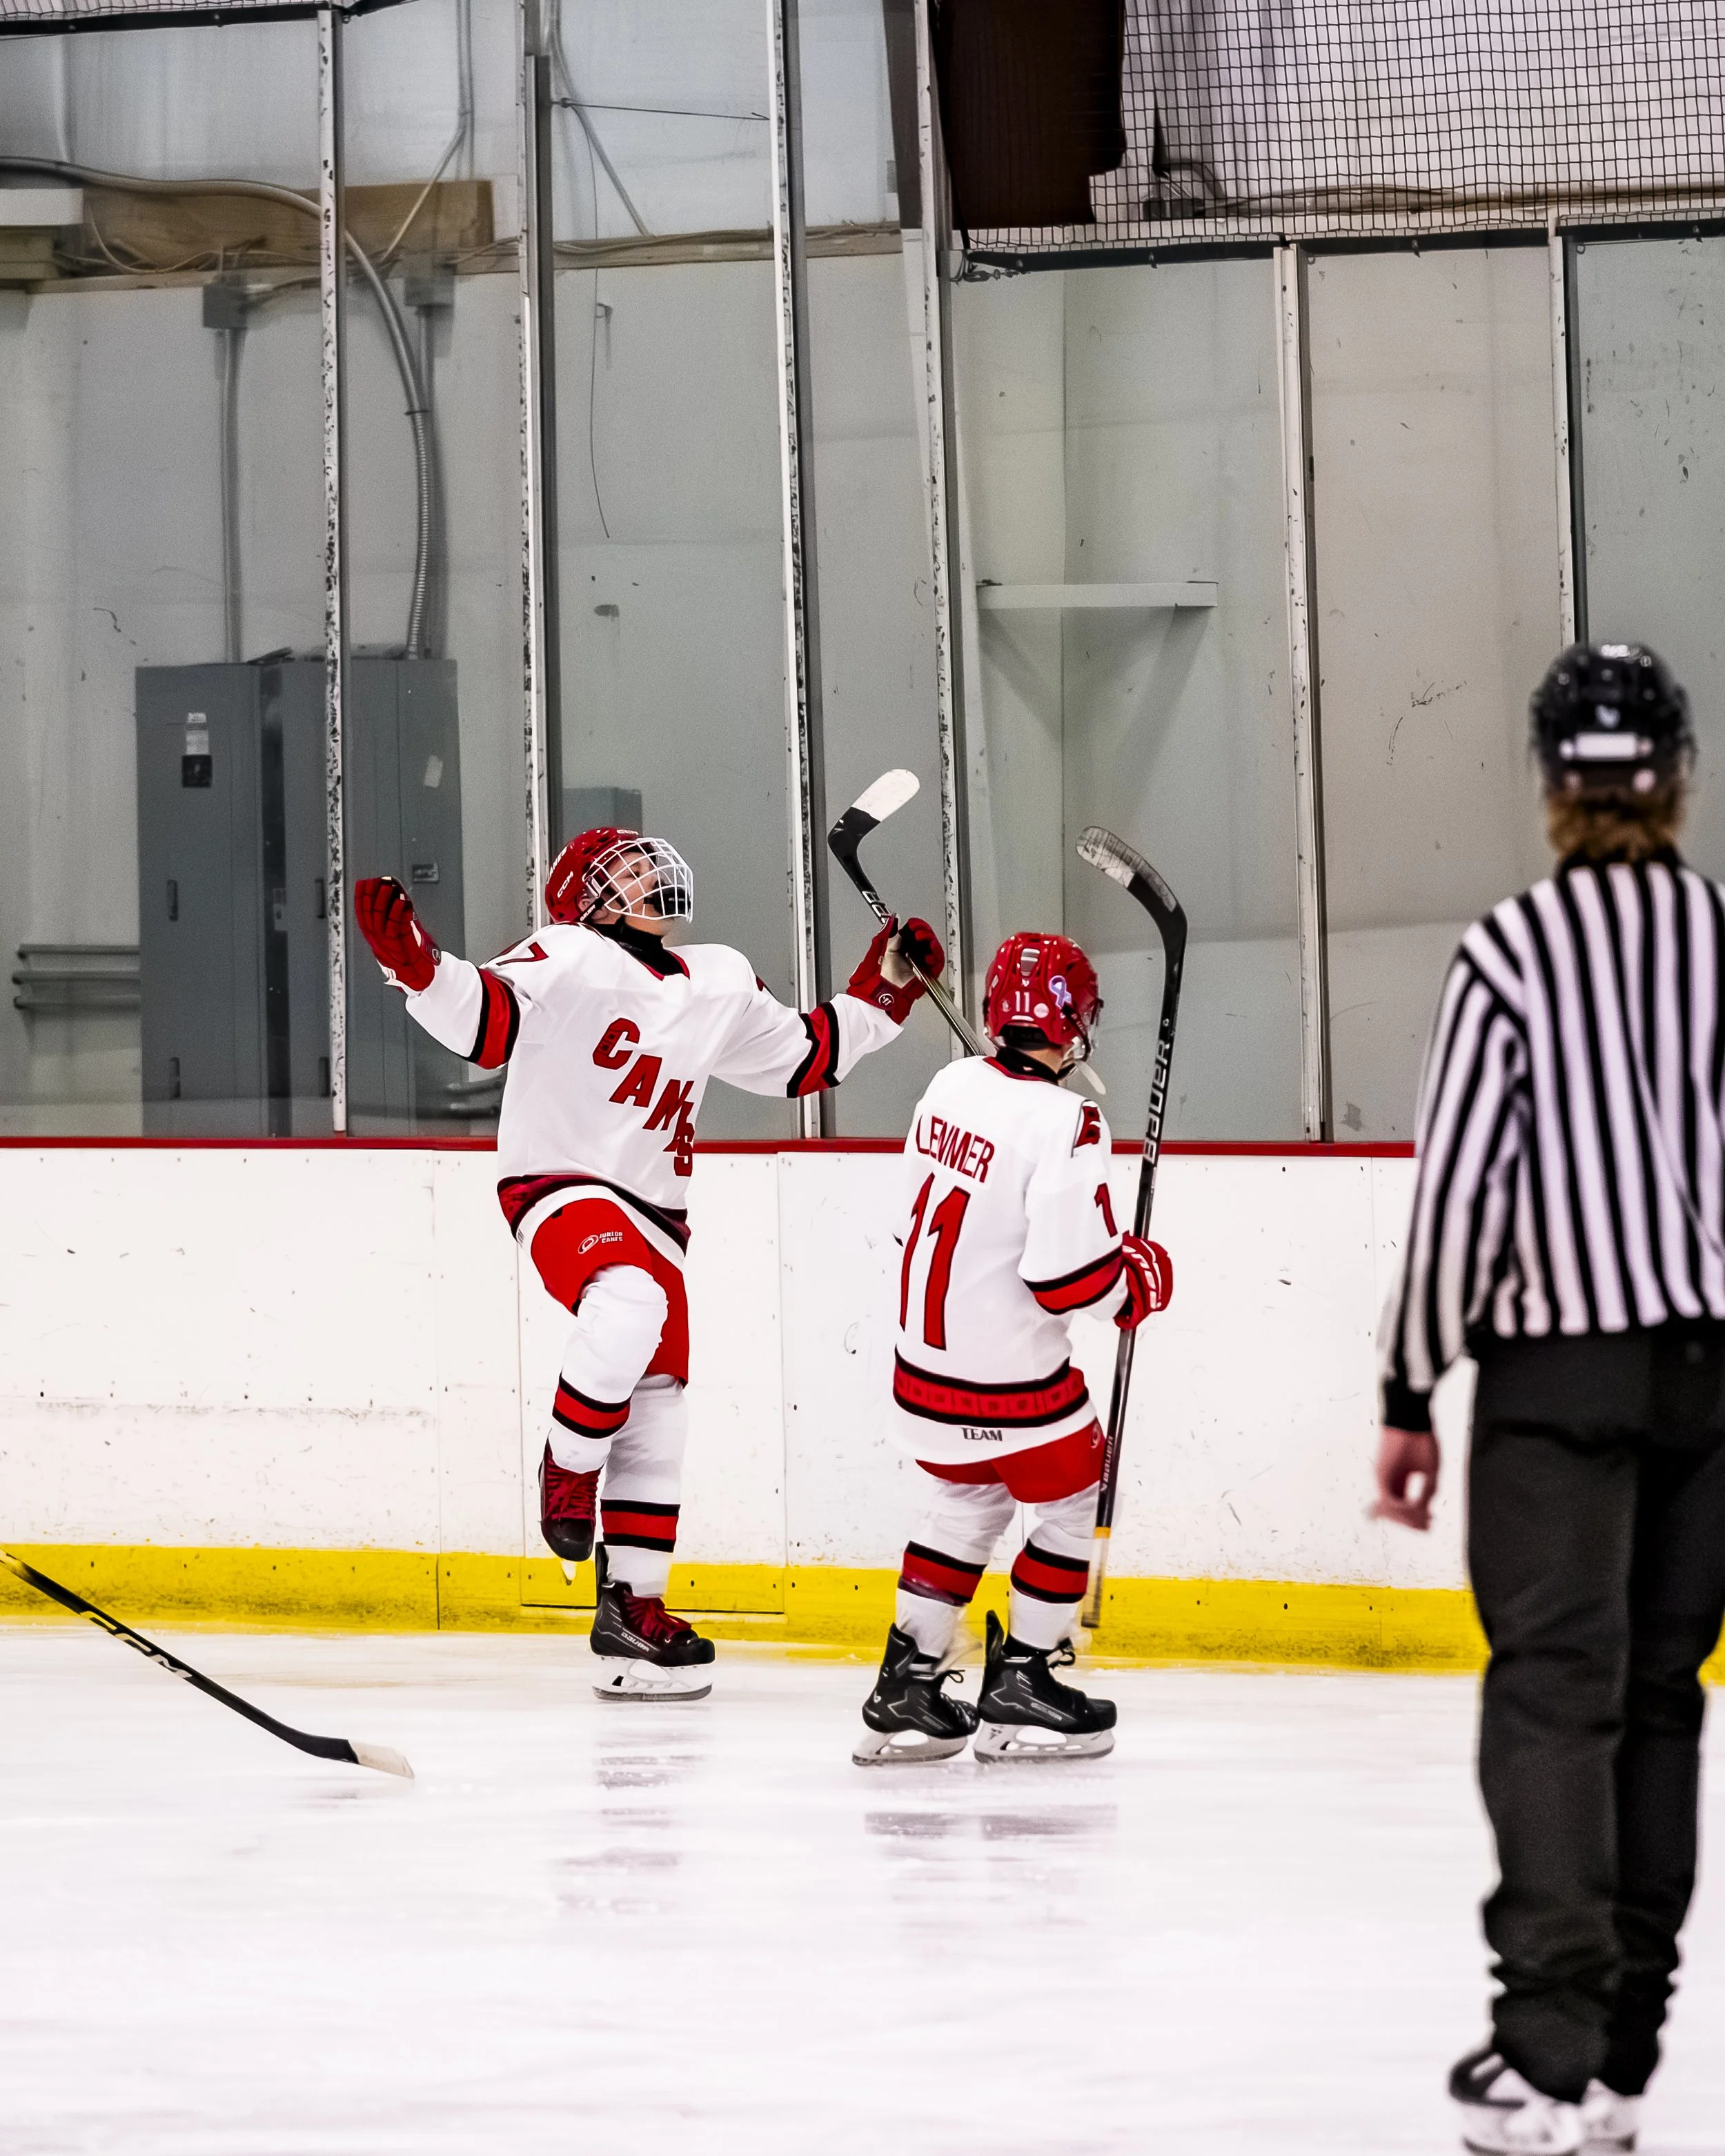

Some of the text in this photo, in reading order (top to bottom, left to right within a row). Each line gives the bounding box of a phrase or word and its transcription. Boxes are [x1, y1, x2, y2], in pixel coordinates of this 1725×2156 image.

[557, 871, 574, 898] CCM
[484, 934, 550, 967] 7
[1015, 991, 1030, 1013] 11
[899, 1171, 972, 1351] 11
[961, 1427, 1003, 1442] TEAM
